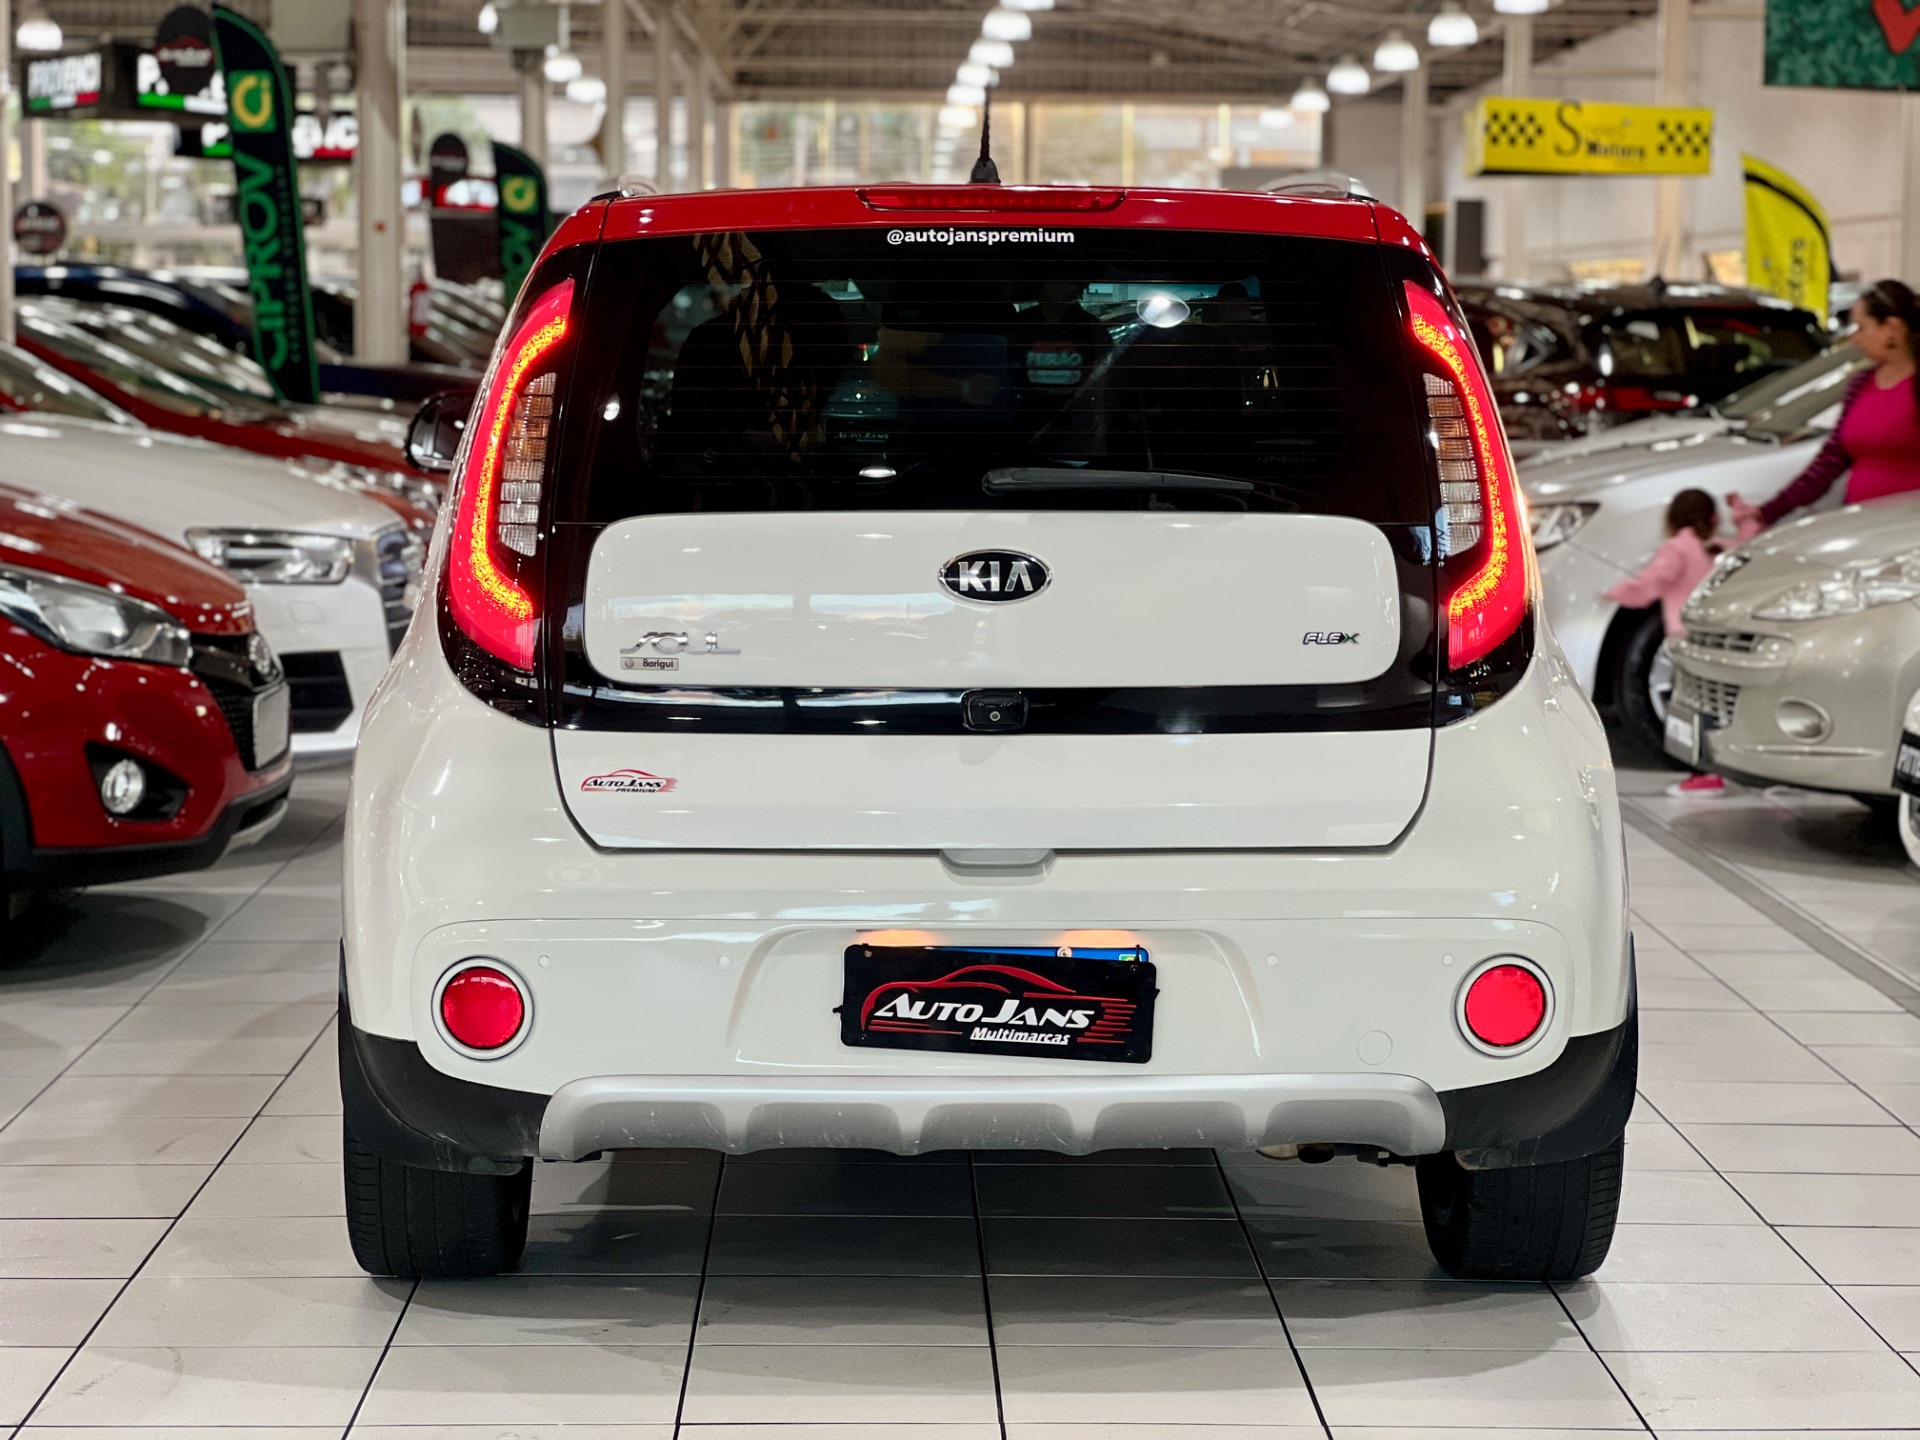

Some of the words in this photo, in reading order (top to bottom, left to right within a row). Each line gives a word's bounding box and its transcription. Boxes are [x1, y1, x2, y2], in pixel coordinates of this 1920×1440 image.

[887, 228, 1075, 246] @autojanspremium
[957, 560, 1034, 592] KIA
[620, 630, 741, 655] SOUL
[1302, 631, 1361, 645] FLEX
[642, 658, 674, 670] Barigui
[969, 1026, 1071, 1046] Multimarcas
